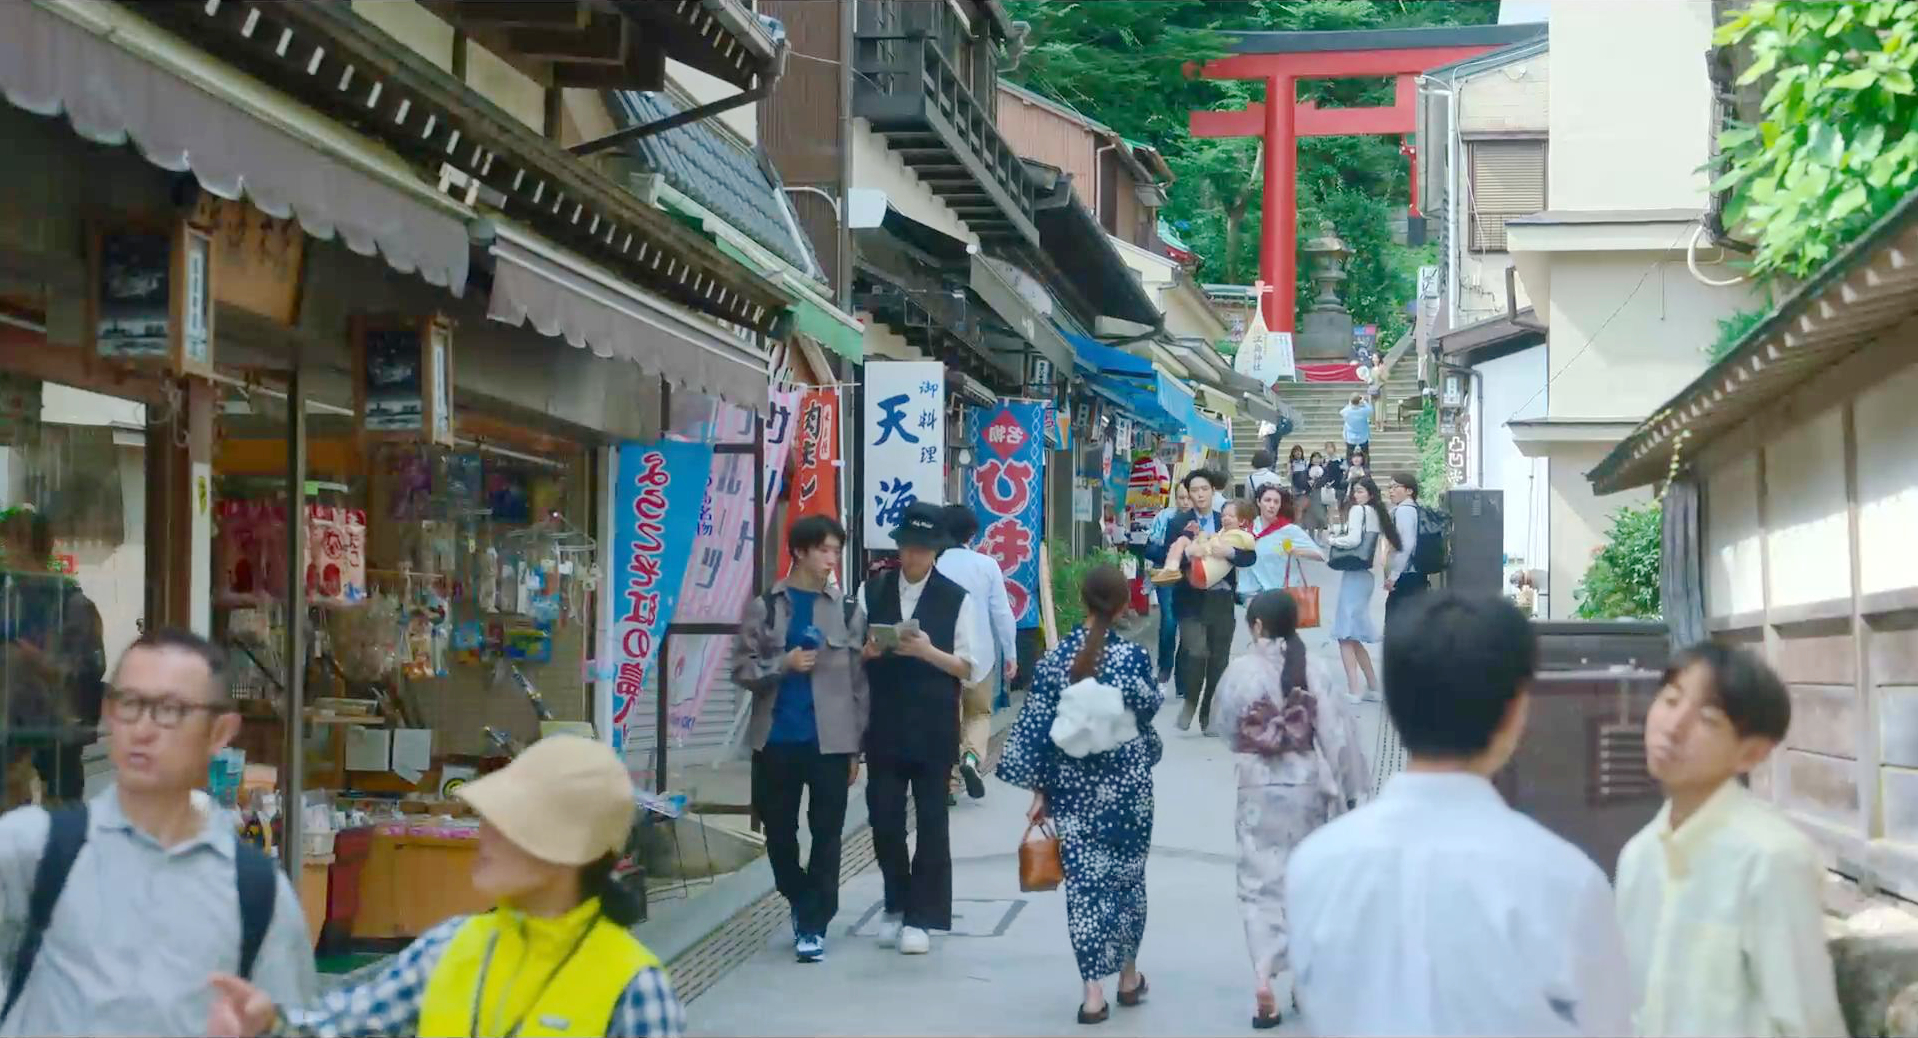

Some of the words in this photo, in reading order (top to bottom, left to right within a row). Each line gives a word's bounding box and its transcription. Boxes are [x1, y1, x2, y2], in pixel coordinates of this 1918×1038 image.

[872, 394, 919, 527] 天海
[918, 381, 938, 463] 御料理
